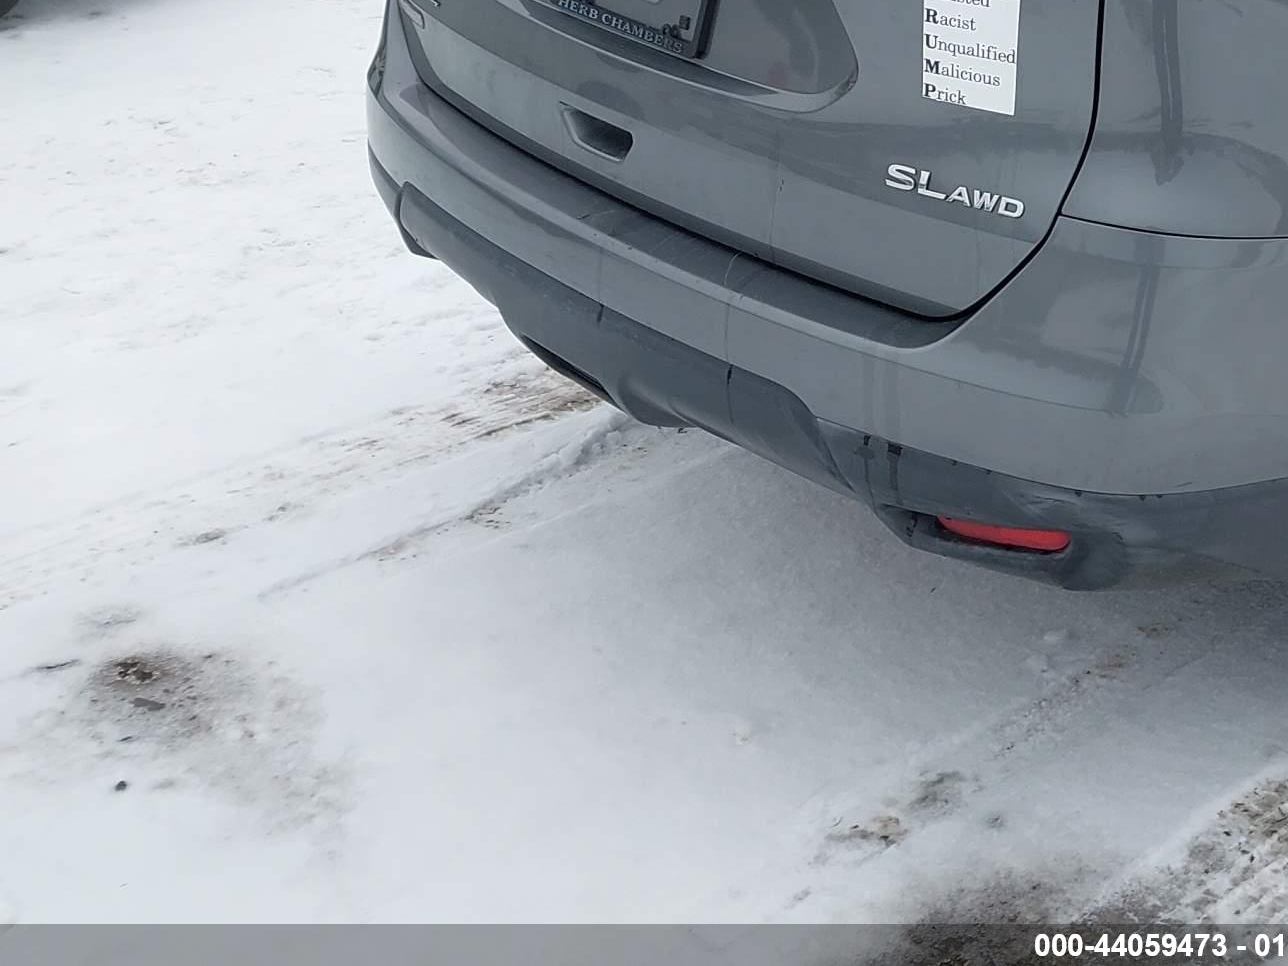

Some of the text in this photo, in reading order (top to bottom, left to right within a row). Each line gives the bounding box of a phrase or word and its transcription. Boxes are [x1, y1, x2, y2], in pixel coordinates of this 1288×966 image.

[601, 7, 684, 54] CHAMBERS
[924, 7, 977, 32] Racist
[925, 33, 1017, 64] Unqualified
[924, 58, 1001, 87] Malicious
[923, 82, 967, 106] Prick
[945, 186, 1025, 219] AWD
